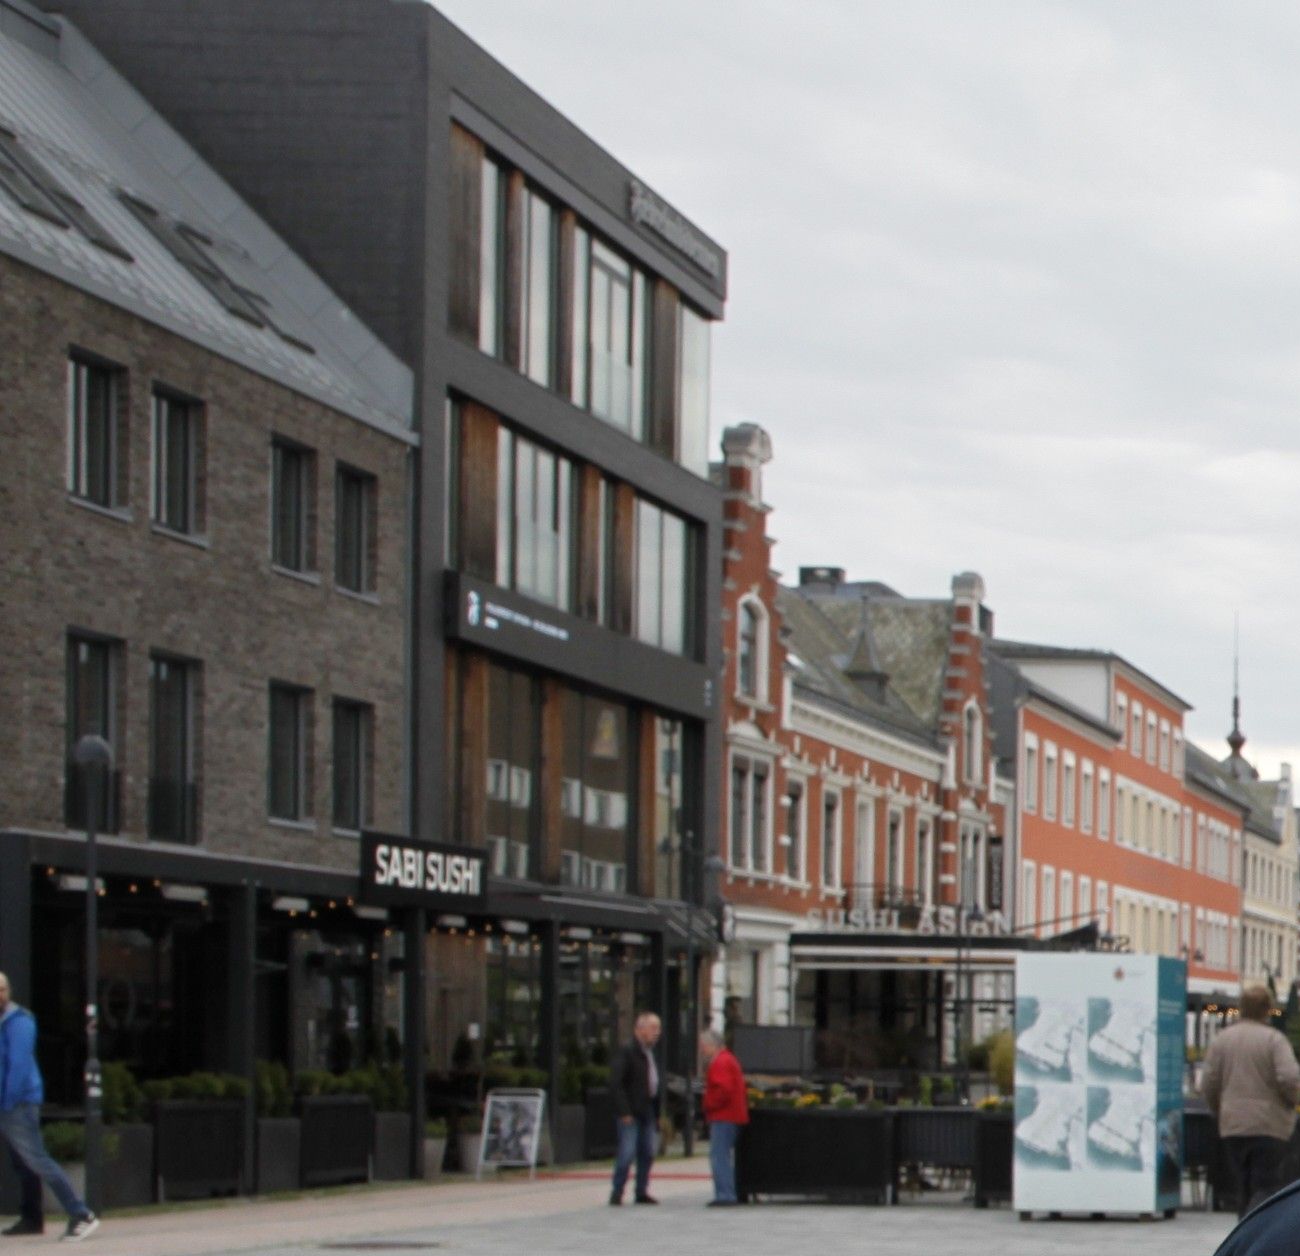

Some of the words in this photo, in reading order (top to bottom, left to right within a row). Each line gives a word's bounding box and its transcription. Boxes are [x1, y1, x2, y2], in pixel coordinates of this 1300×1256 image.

[375, 844, 424, 888] SABI
[425, 851, 480, 895] SUSHI
[807, 907, 900, 931] SUSHI
